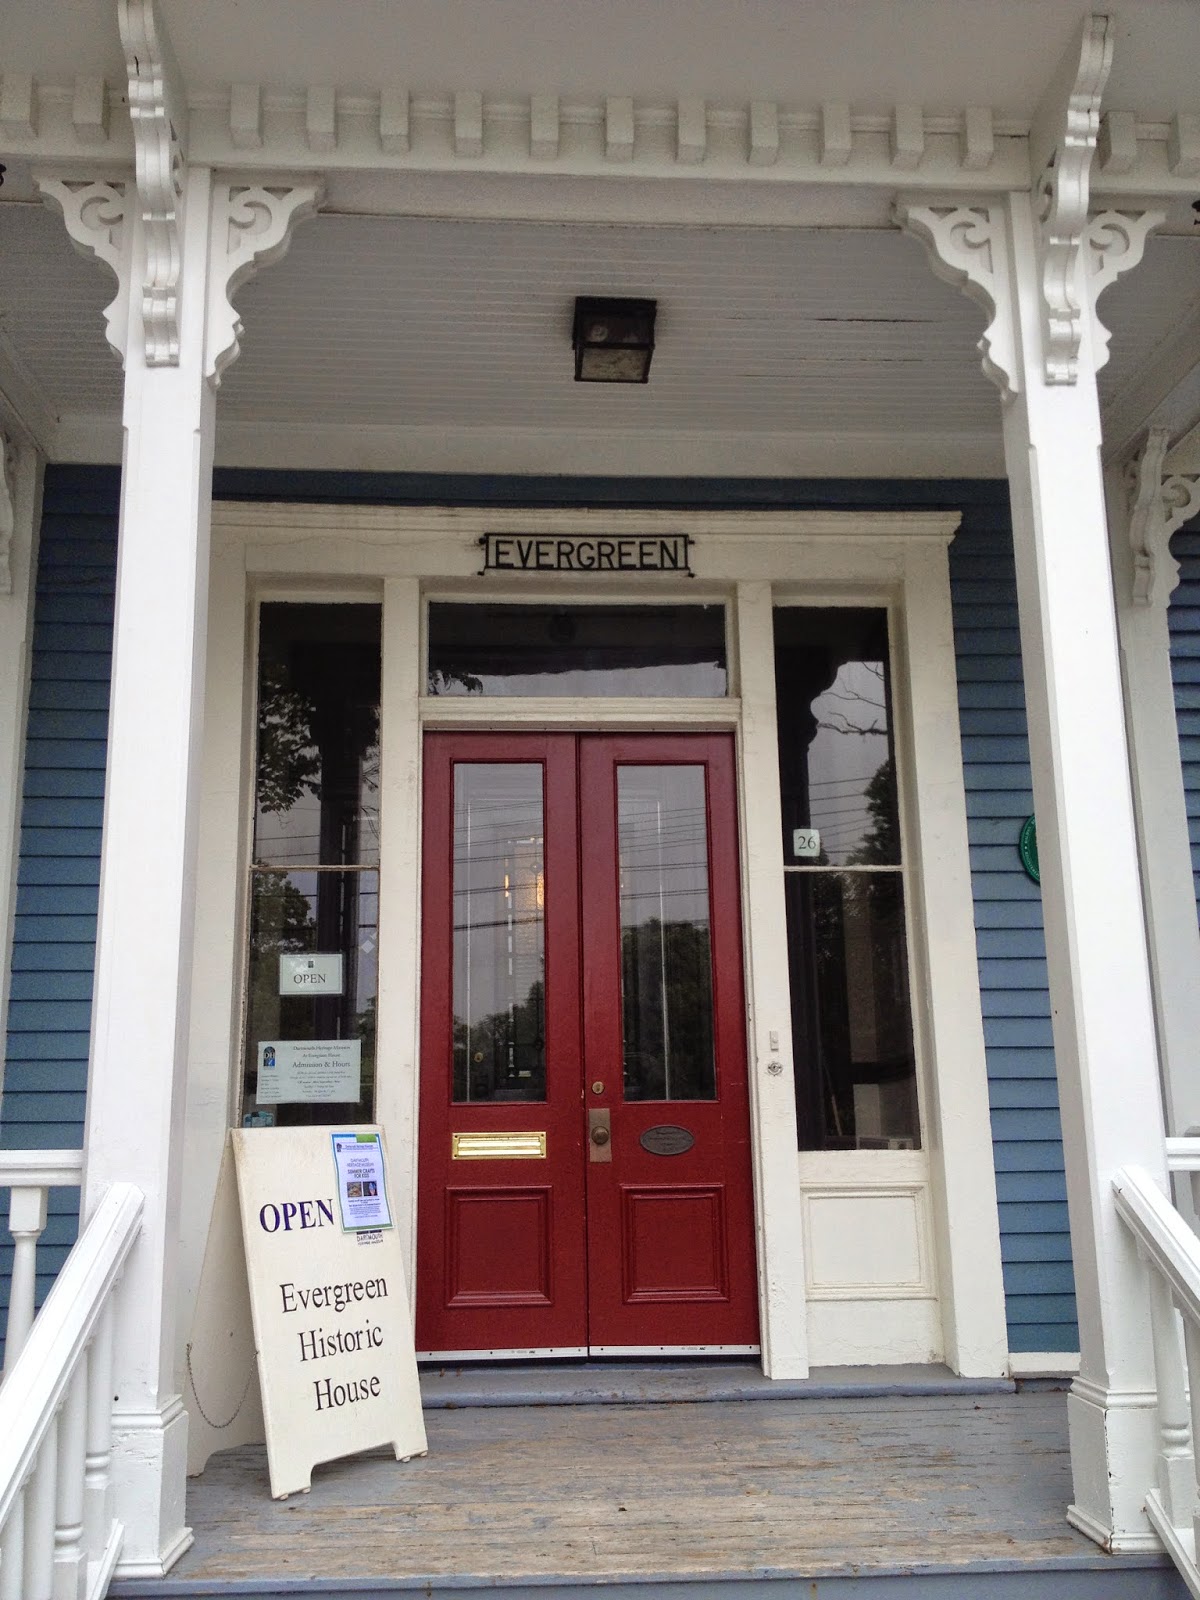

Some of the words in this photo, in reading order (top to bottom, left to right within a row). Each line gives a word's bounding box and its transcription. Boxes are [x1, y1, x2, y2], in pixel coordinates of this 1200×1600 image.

[495, 539, 678, 569] EVERGREEN
[798, 835, 816, 850] 26
[293, 973, 326, 984] OPEN
[259, 1198, 334, 1233] OPEN
[356, 1233, 383, 1242] DARTMOUTH
[279, 1277, 389, 1314] Evergreen
[298, 1319, 384, 1362] Historic
[313, 1376, 381, 1412] House
